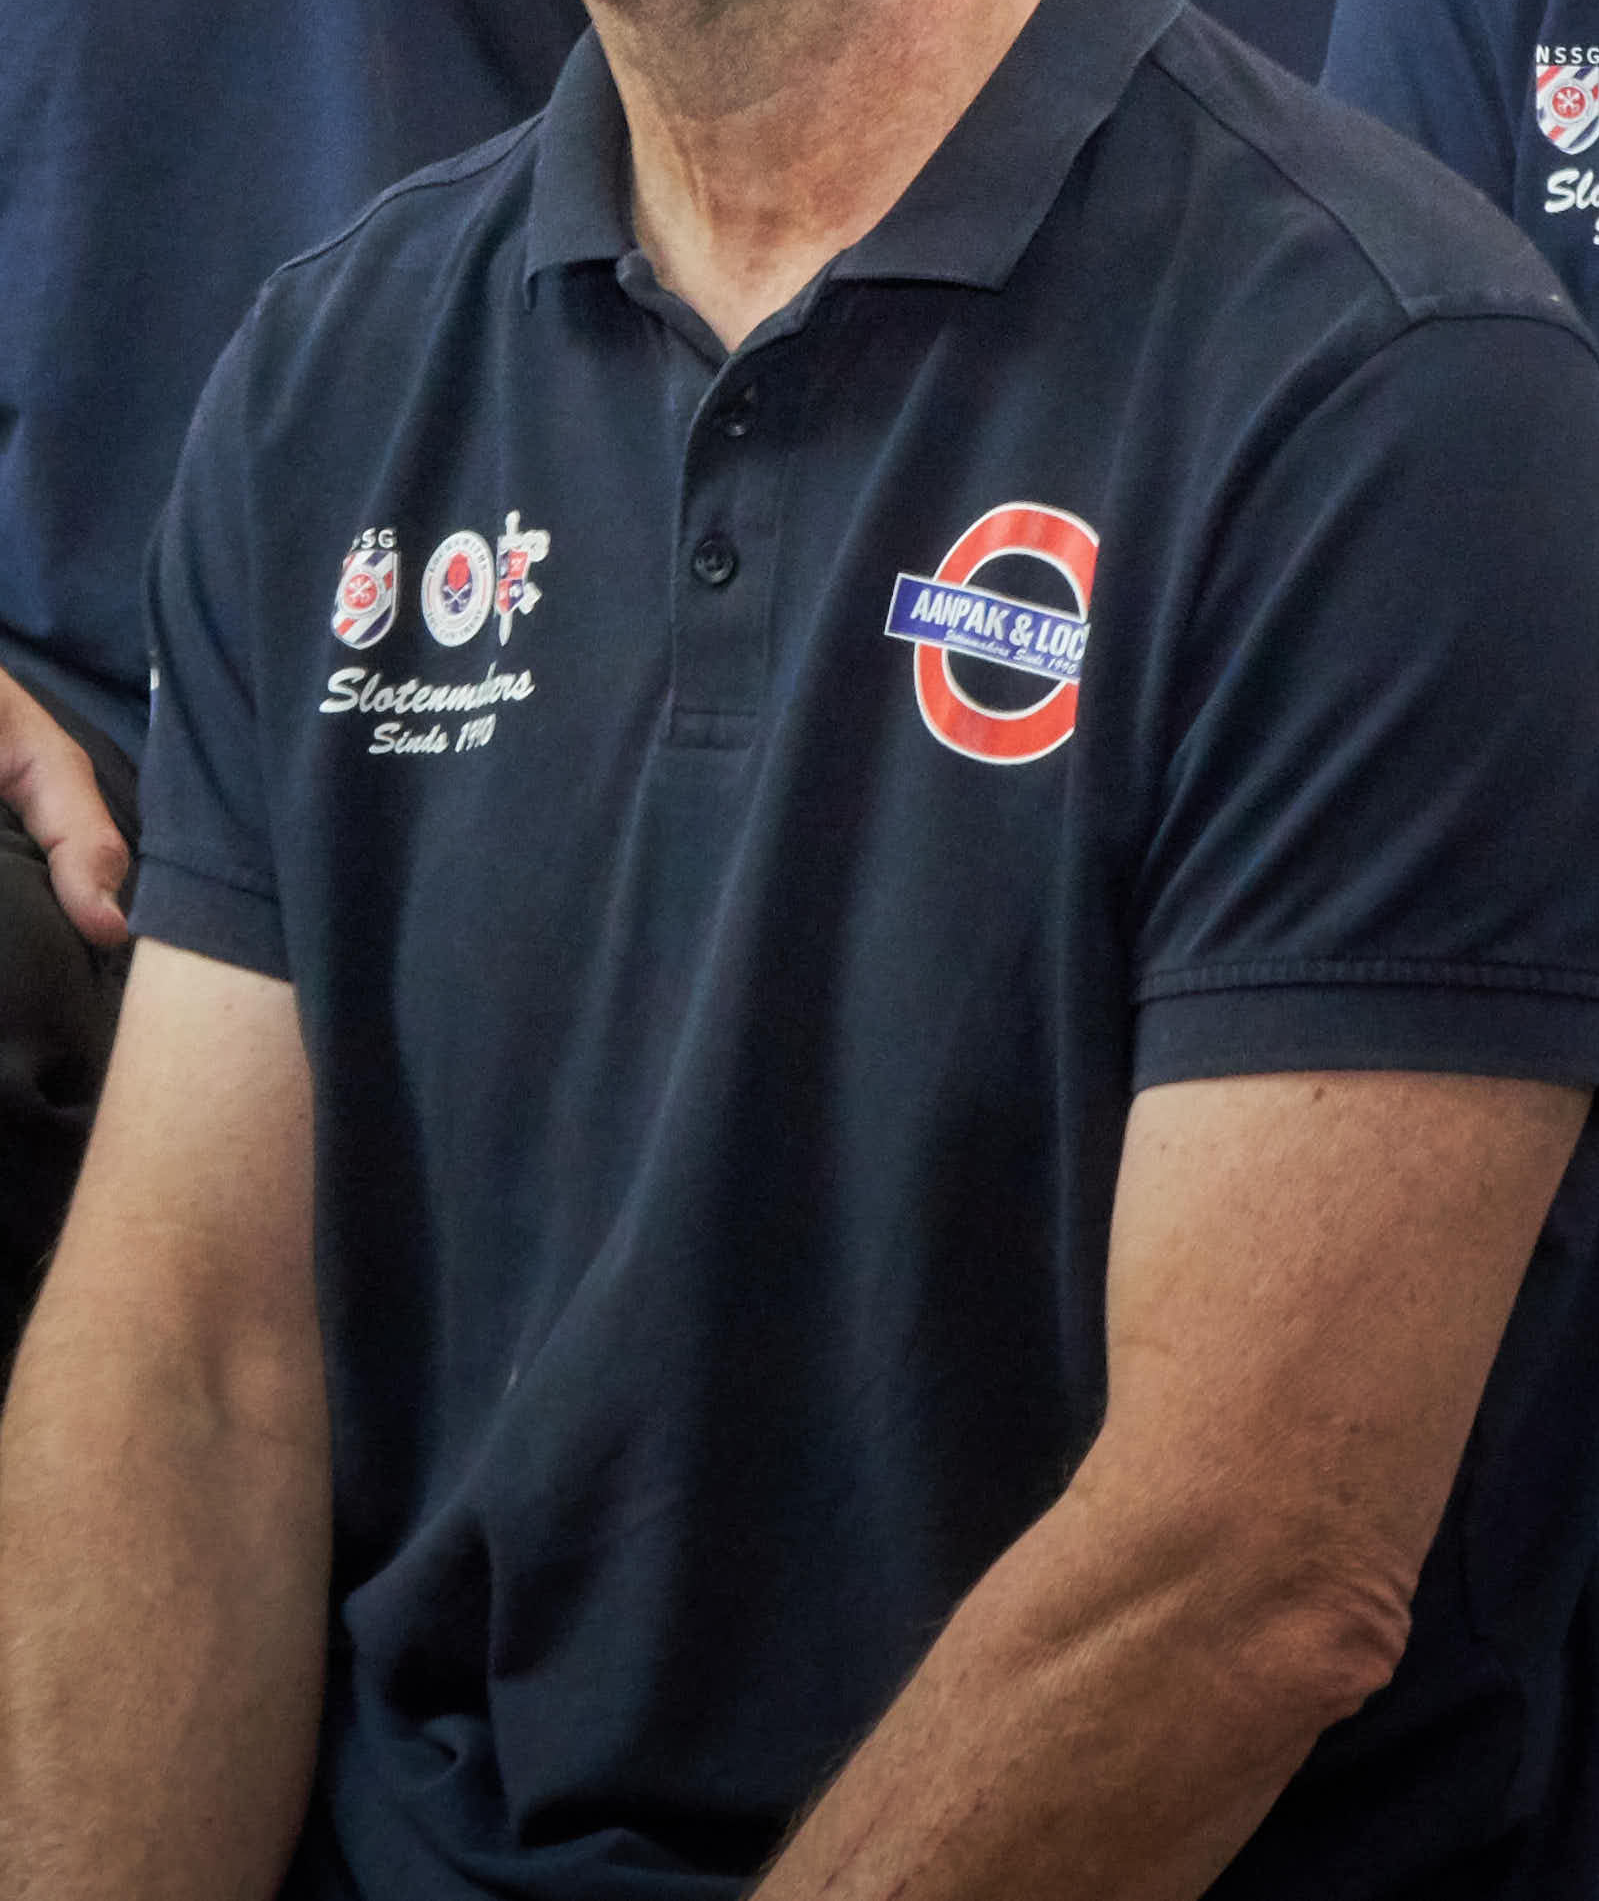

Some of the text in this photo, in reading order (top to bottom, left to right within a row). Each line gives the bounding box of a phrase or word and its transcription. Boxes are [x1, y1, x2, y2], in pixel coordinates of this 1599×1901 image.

[351, 527, 399, 550] SG
[909, 587, 1091, 662] AANPAK & LOC
[368, 721, 449, 755] Sinds
